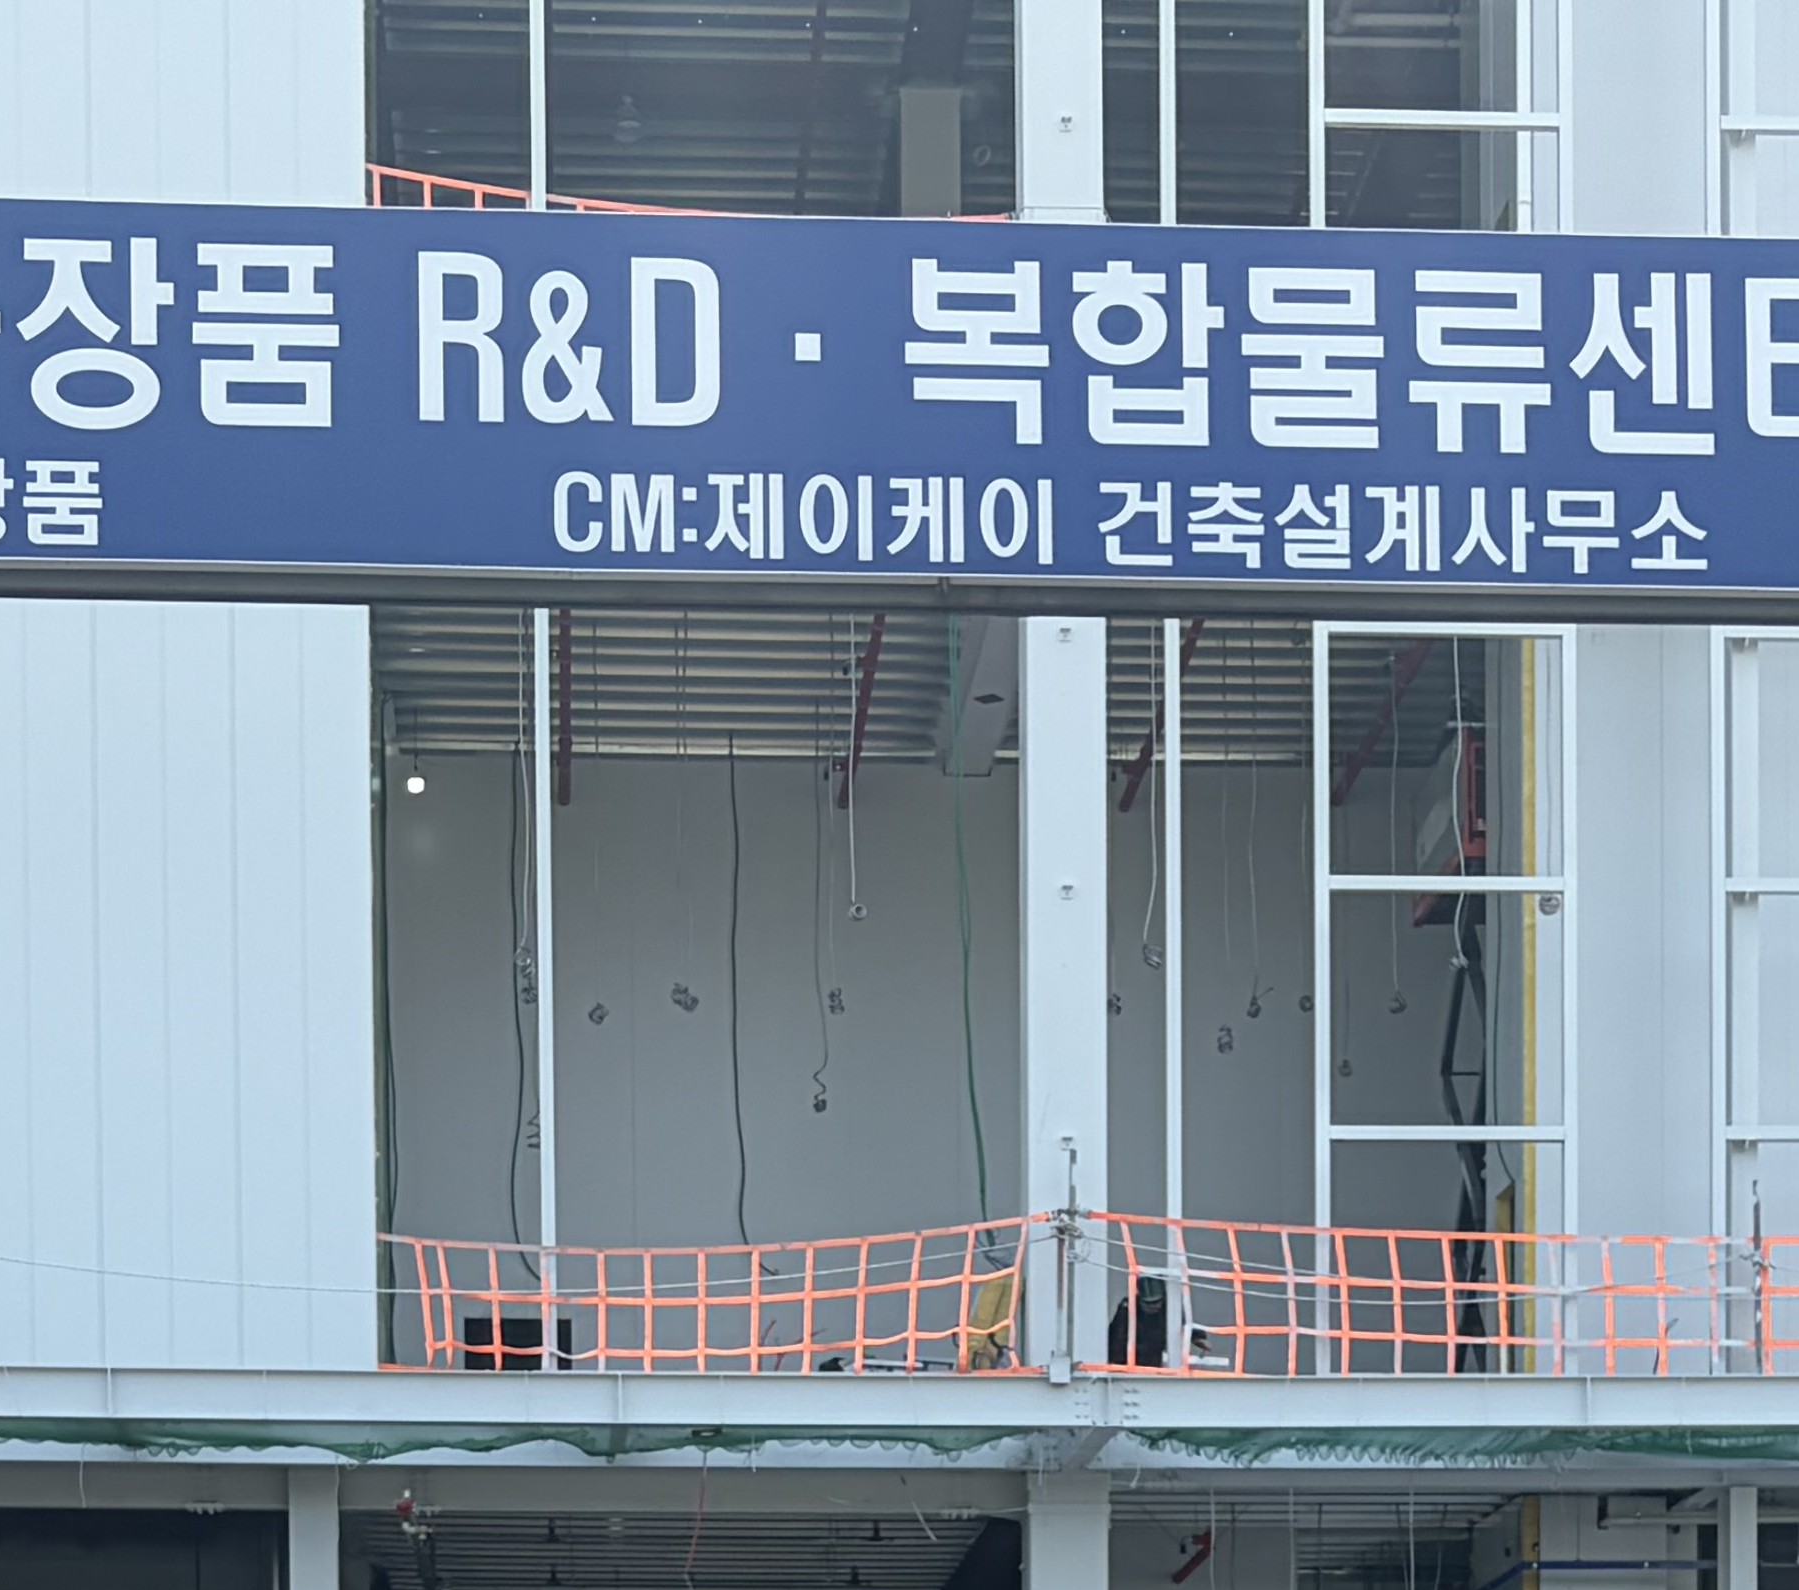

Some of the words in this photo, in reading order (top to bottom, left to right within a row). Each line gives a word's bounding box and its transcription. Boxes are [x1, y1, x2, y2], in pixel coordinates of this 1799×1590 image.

[418, 249, 721, 426] R&D
[552, 470, 1054, 564] CM:제이케이
[1097, 479, 1709, 577] 건축설계사무소
